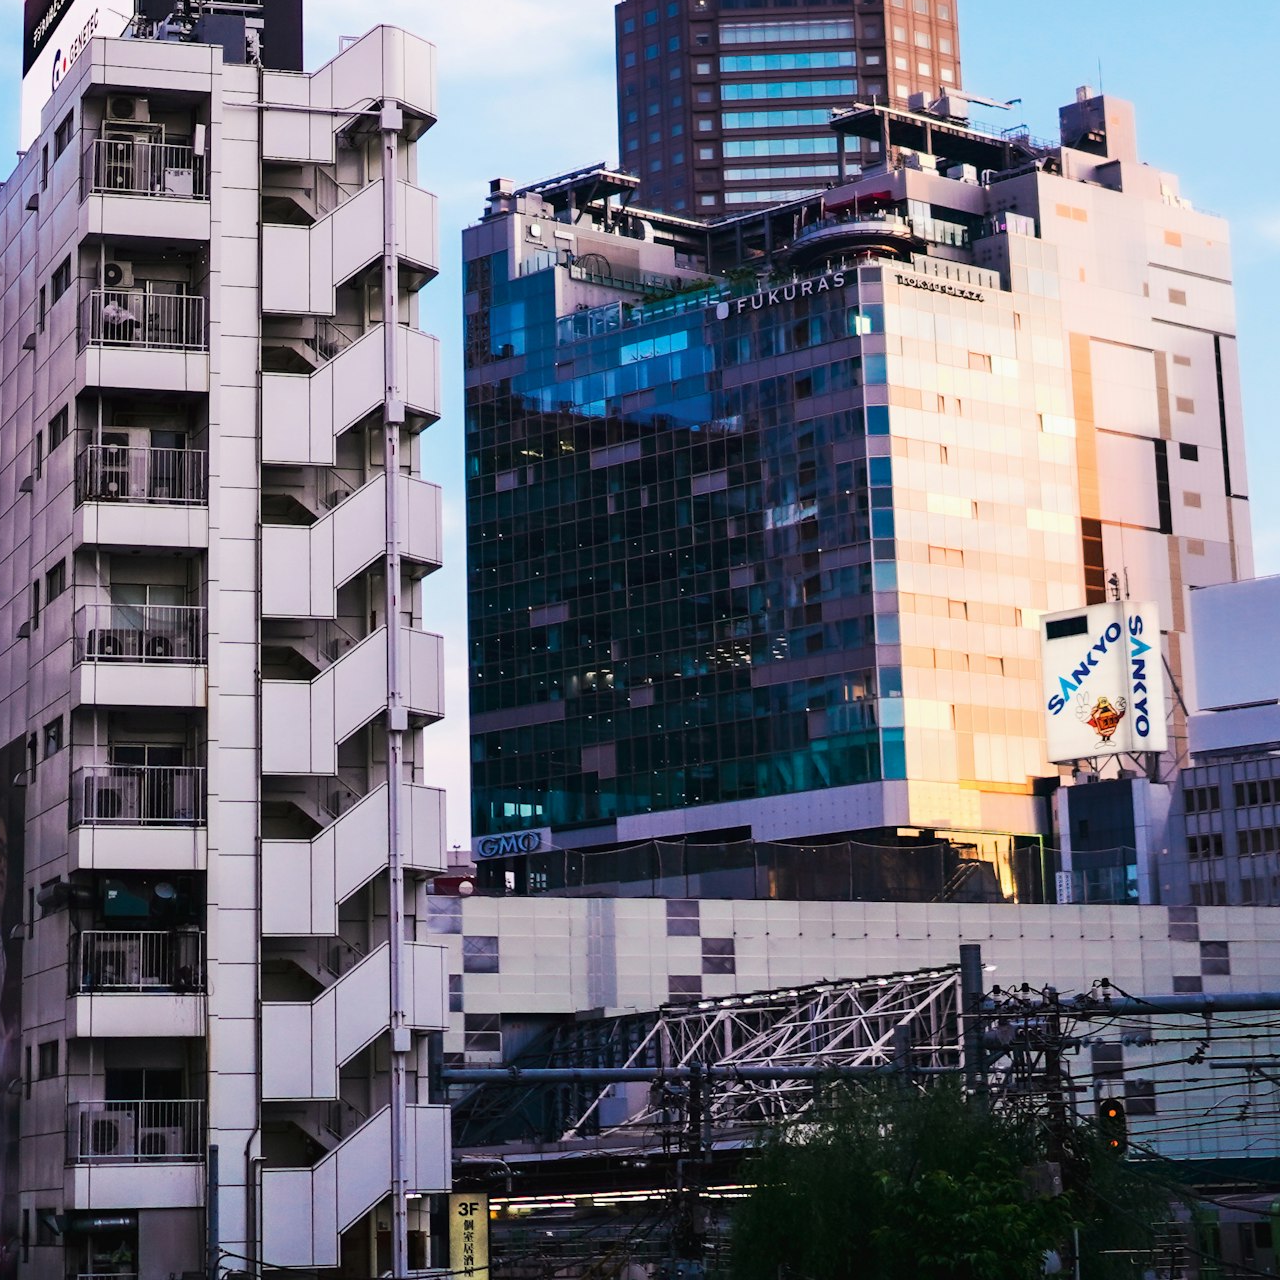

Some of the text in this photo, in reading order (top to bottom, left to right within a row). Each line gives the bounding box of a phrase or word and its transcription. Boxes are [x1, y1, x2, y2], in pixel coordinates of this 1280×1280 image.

[69, 8, 98, 64] GENETEC
[737, 273, 846, 314] FUKURAS
[1048, 622, 1122, 716] SANKYO
[1128, 615, 1152, 738] SANKYO
[478, 831, 541, 858] GMO
[458, 1202, 479, 1216] 3F
